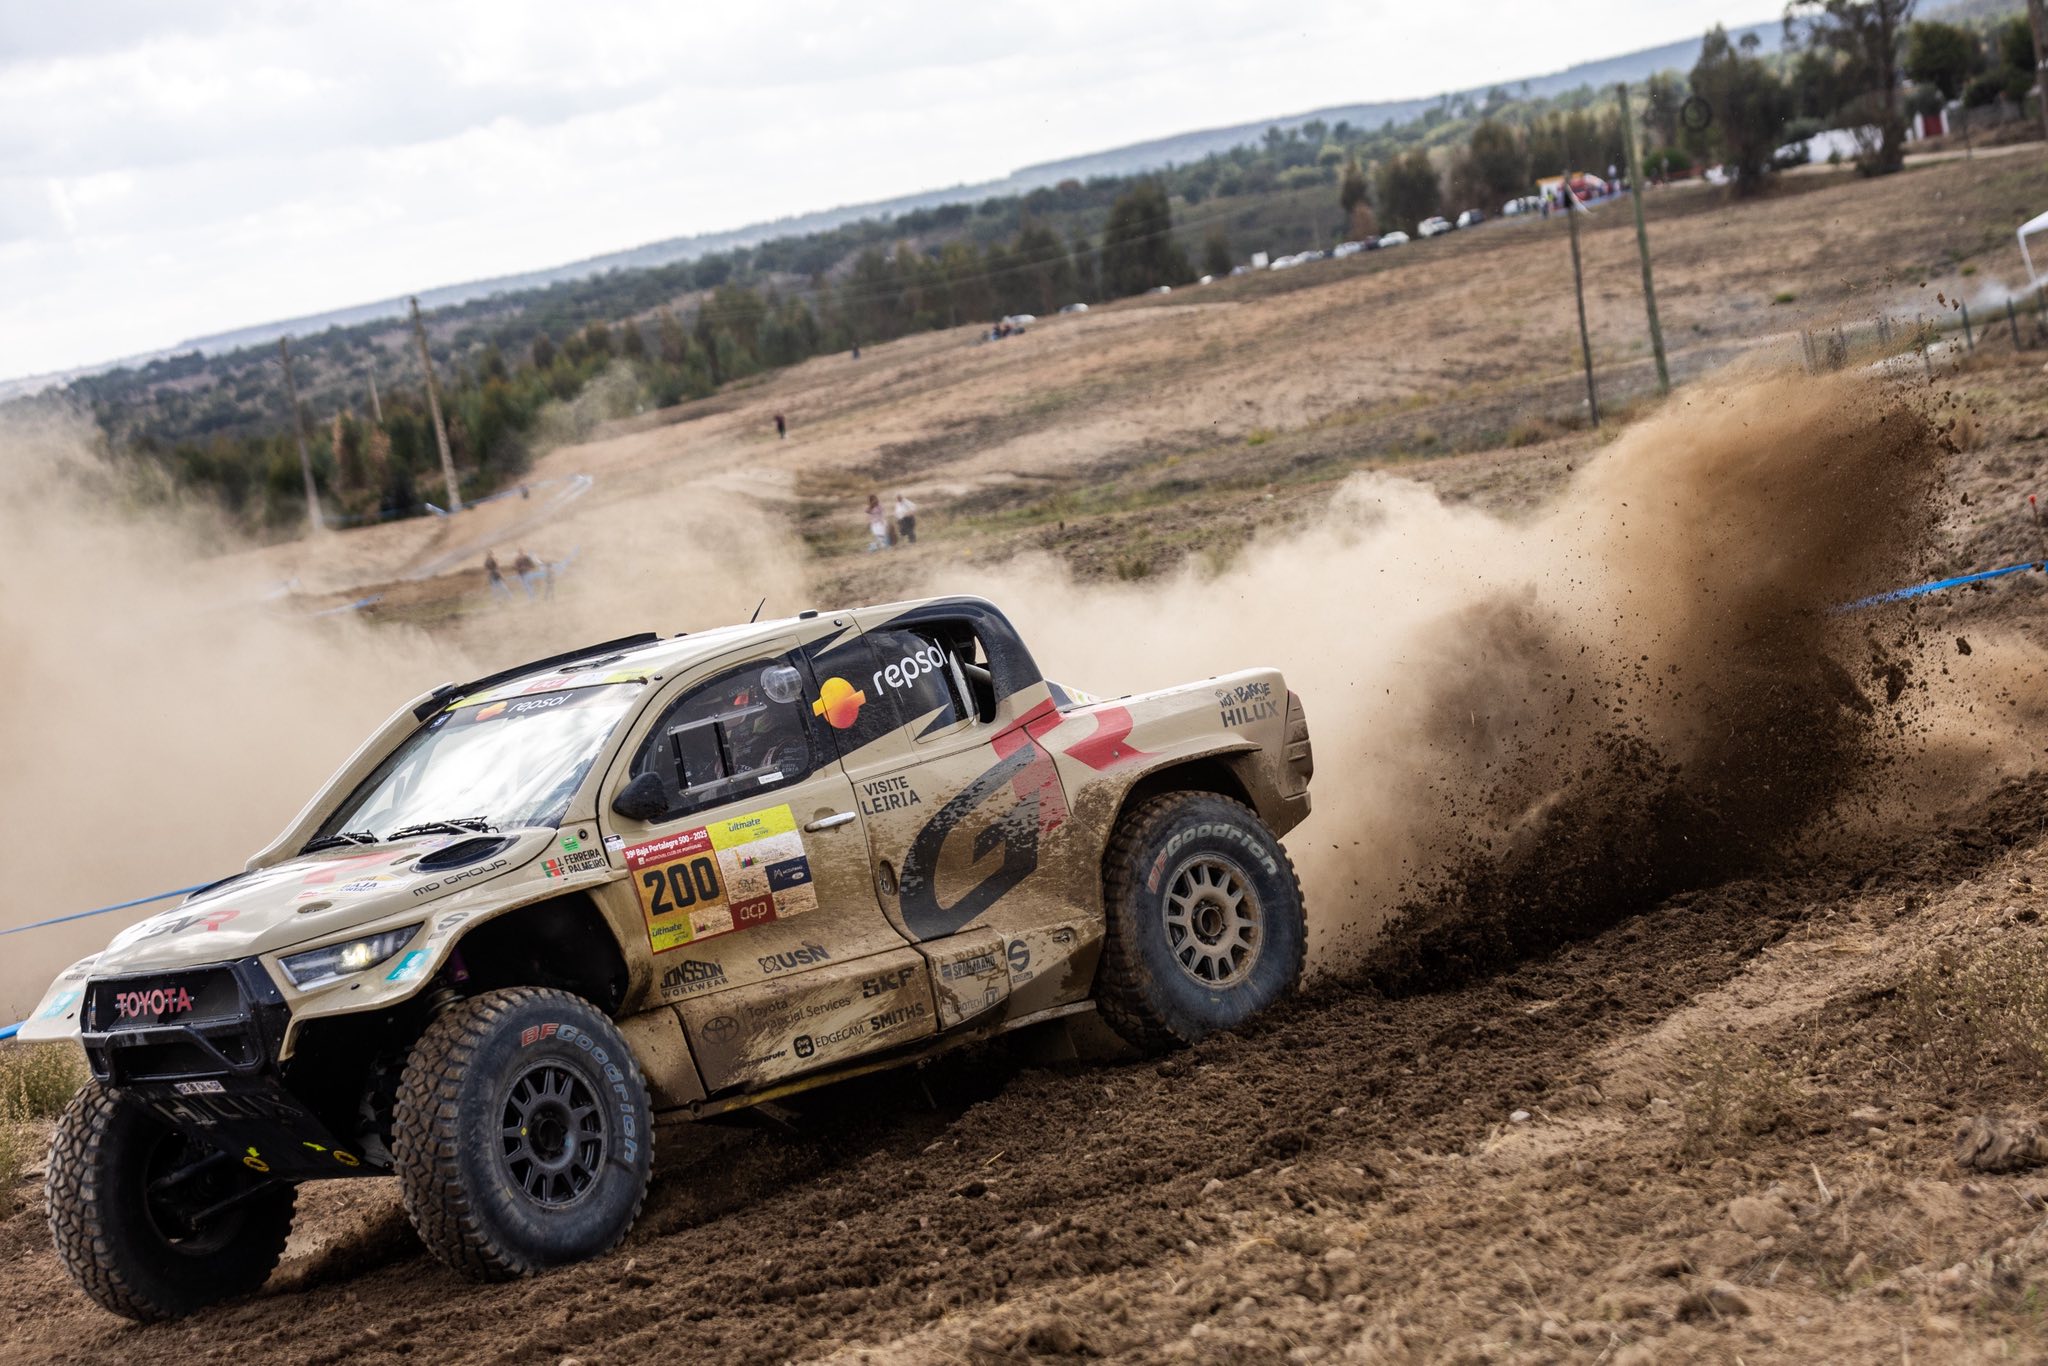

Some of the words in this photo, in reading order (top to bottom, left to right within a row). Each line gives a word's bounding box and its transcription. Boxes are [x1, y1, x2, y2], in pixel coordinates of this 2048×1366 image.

[873, 638, 948, 696] repsol
[508, 693, 573, 713] repsol
[1221, 700, 1279, 728] HILUX
[863, 776, 909, 796] VISITE
[861, 789, 921, 816] LEIRIA
[636, 846, 650, 857] Baja
[648, 838, 679, 853] Portalegre
[678, 834, 690, 845] 500
[693, 830, 707, 841] 2025
[564, 848, 601, 865] FERREIRA
[568, 858, 606, 874] PALMEIRO
[412, 882, 440, 897] MD
[643, 856, 720, 916] 200
[740, 902, 767, 920] acp
[780, 943, 832, 969] USN
[660, 960, 724, 988] JONSSON
[862, 966, 914, 999] SKF
[661, 977, 728, 998] WORKWEAR
[117, 987, 193, 1018] TOYOTA
[747, 1000, 788, 1018] Toyota
[807, 997, 851, 1018] Services
[870, 1003, 925, 1031] SMITHS
[816, 1025, 865, 1048] EDGECAM
